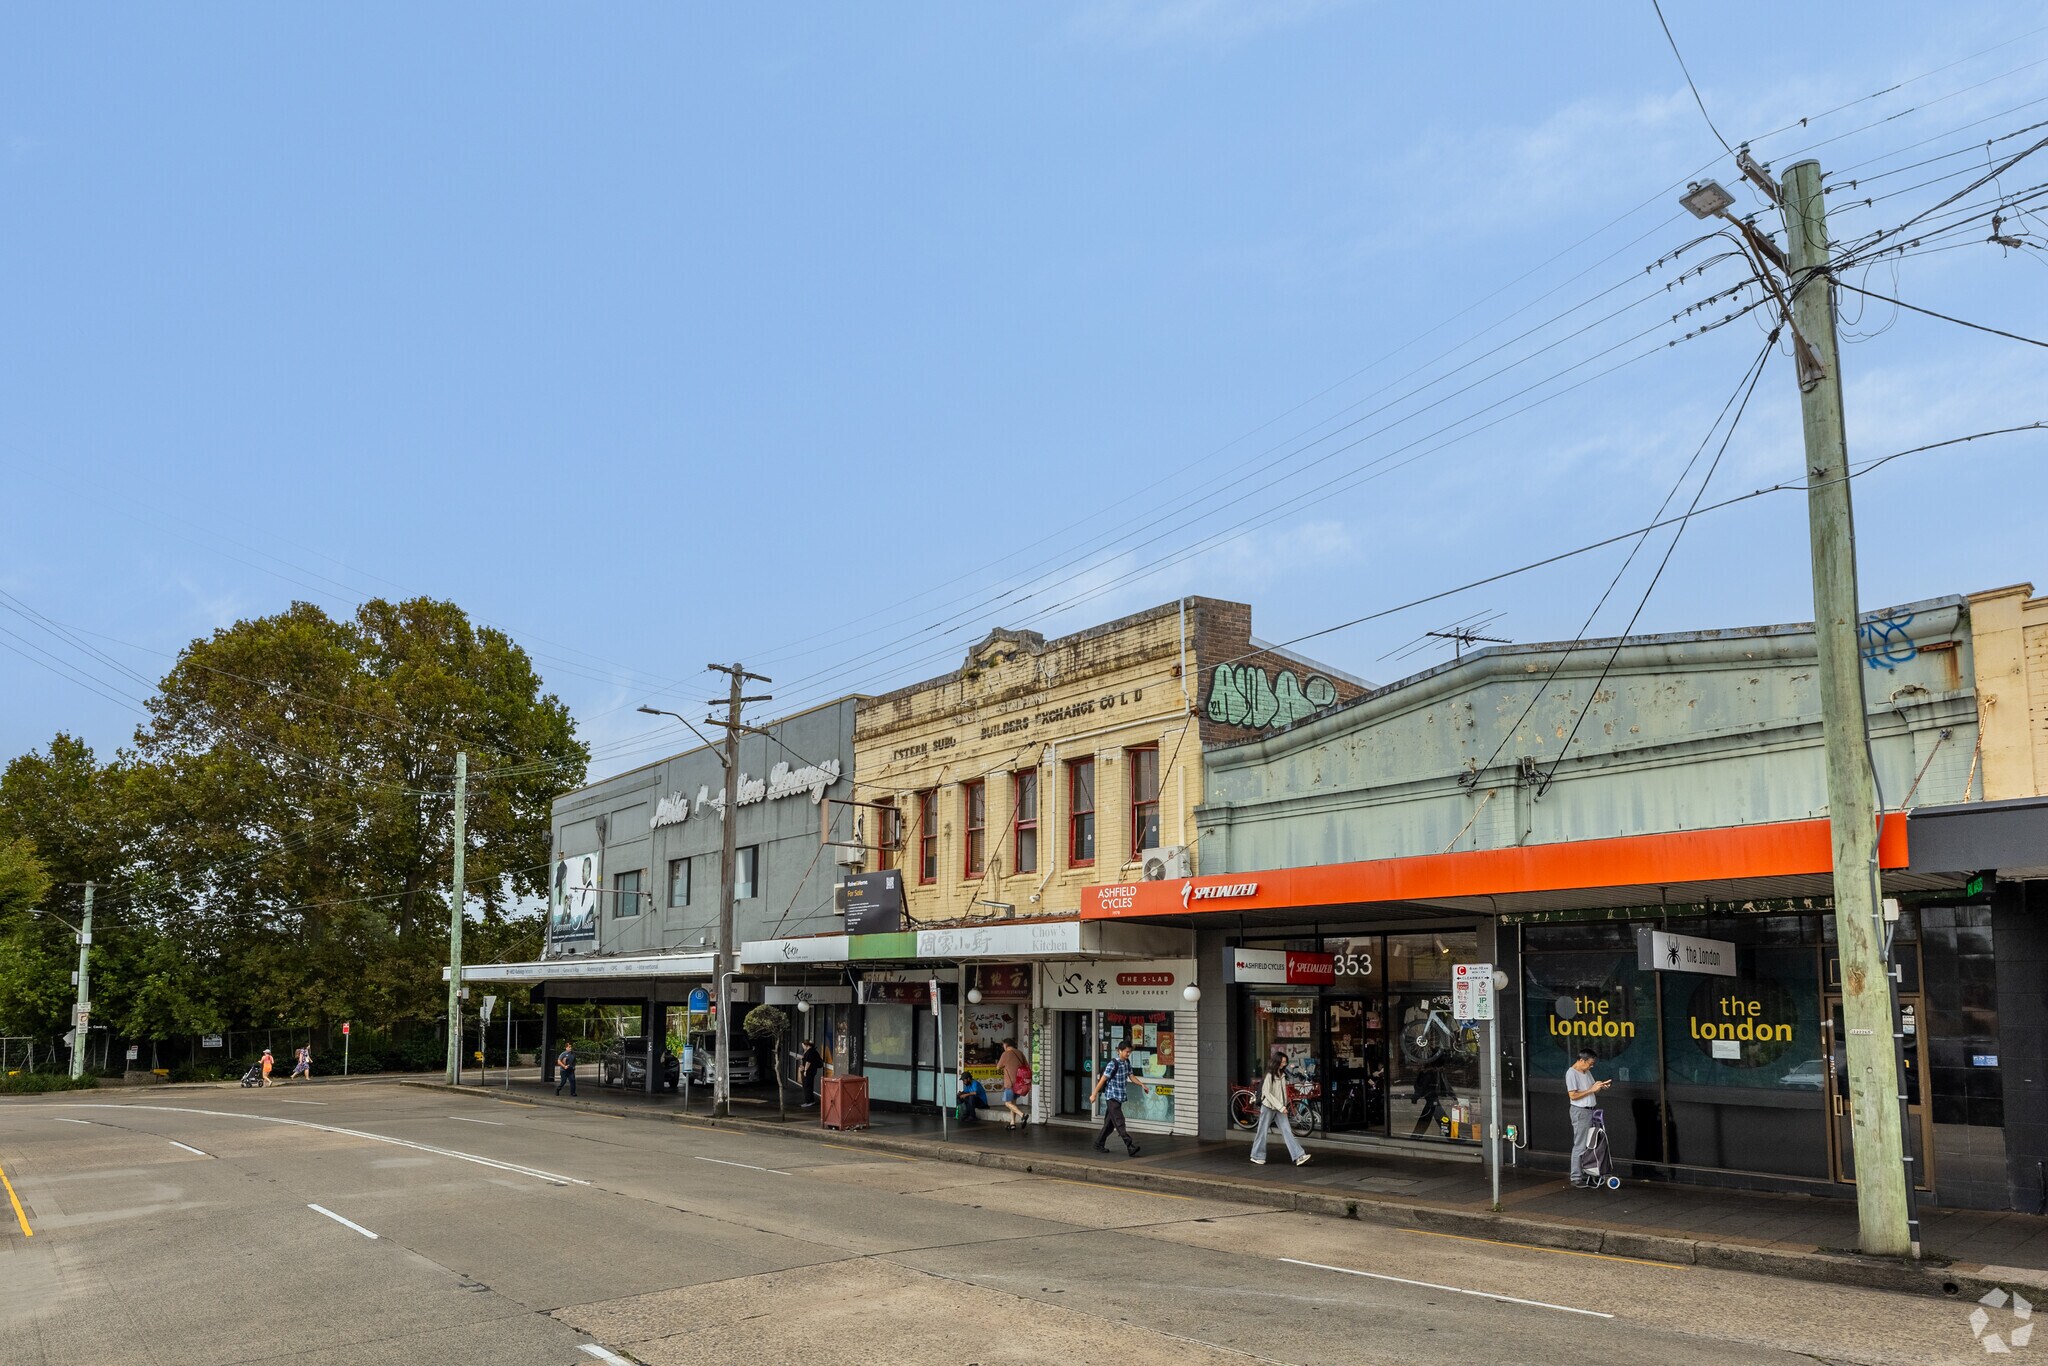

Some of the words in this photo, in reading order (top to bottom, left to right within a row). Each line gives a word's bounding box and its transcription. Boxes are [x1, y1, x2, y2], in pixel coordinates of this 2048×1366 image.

[980, 717, 1030, 740] BUILDERS
[1100, 695, 1115, 710] CO
[1097, 886, 1137, 899] ASHFIELD
[1192, 883, 1257, 899] SPECIALIZED
[1101, 898, 1133, 910] CYCLES
[1032, 926, 1066, 938] Chow's
[1032, 939, 1068, 952] Kitchen
[1686, 945, 1697, 964] the
[1698, 947, 1721, 966] london
[1245, 962, 1267, 970] ASHFIELD
[1267, 963, 1285, 971] CYCLES
[1296, 963, 1332, 974] SPECIALIZED
[1334, 954, 1372, 976] 353
[1058, 973, 1108, 997] 心食堂
[1263, 1006, 1289, 1014] ASHFIELD
[1574, 995, 1610, 1014] the
[1719, 995, 1761, 1017] the
[1549, 1014, 1635, 1038] london
[1690, 1017, 1793, 1042] london
